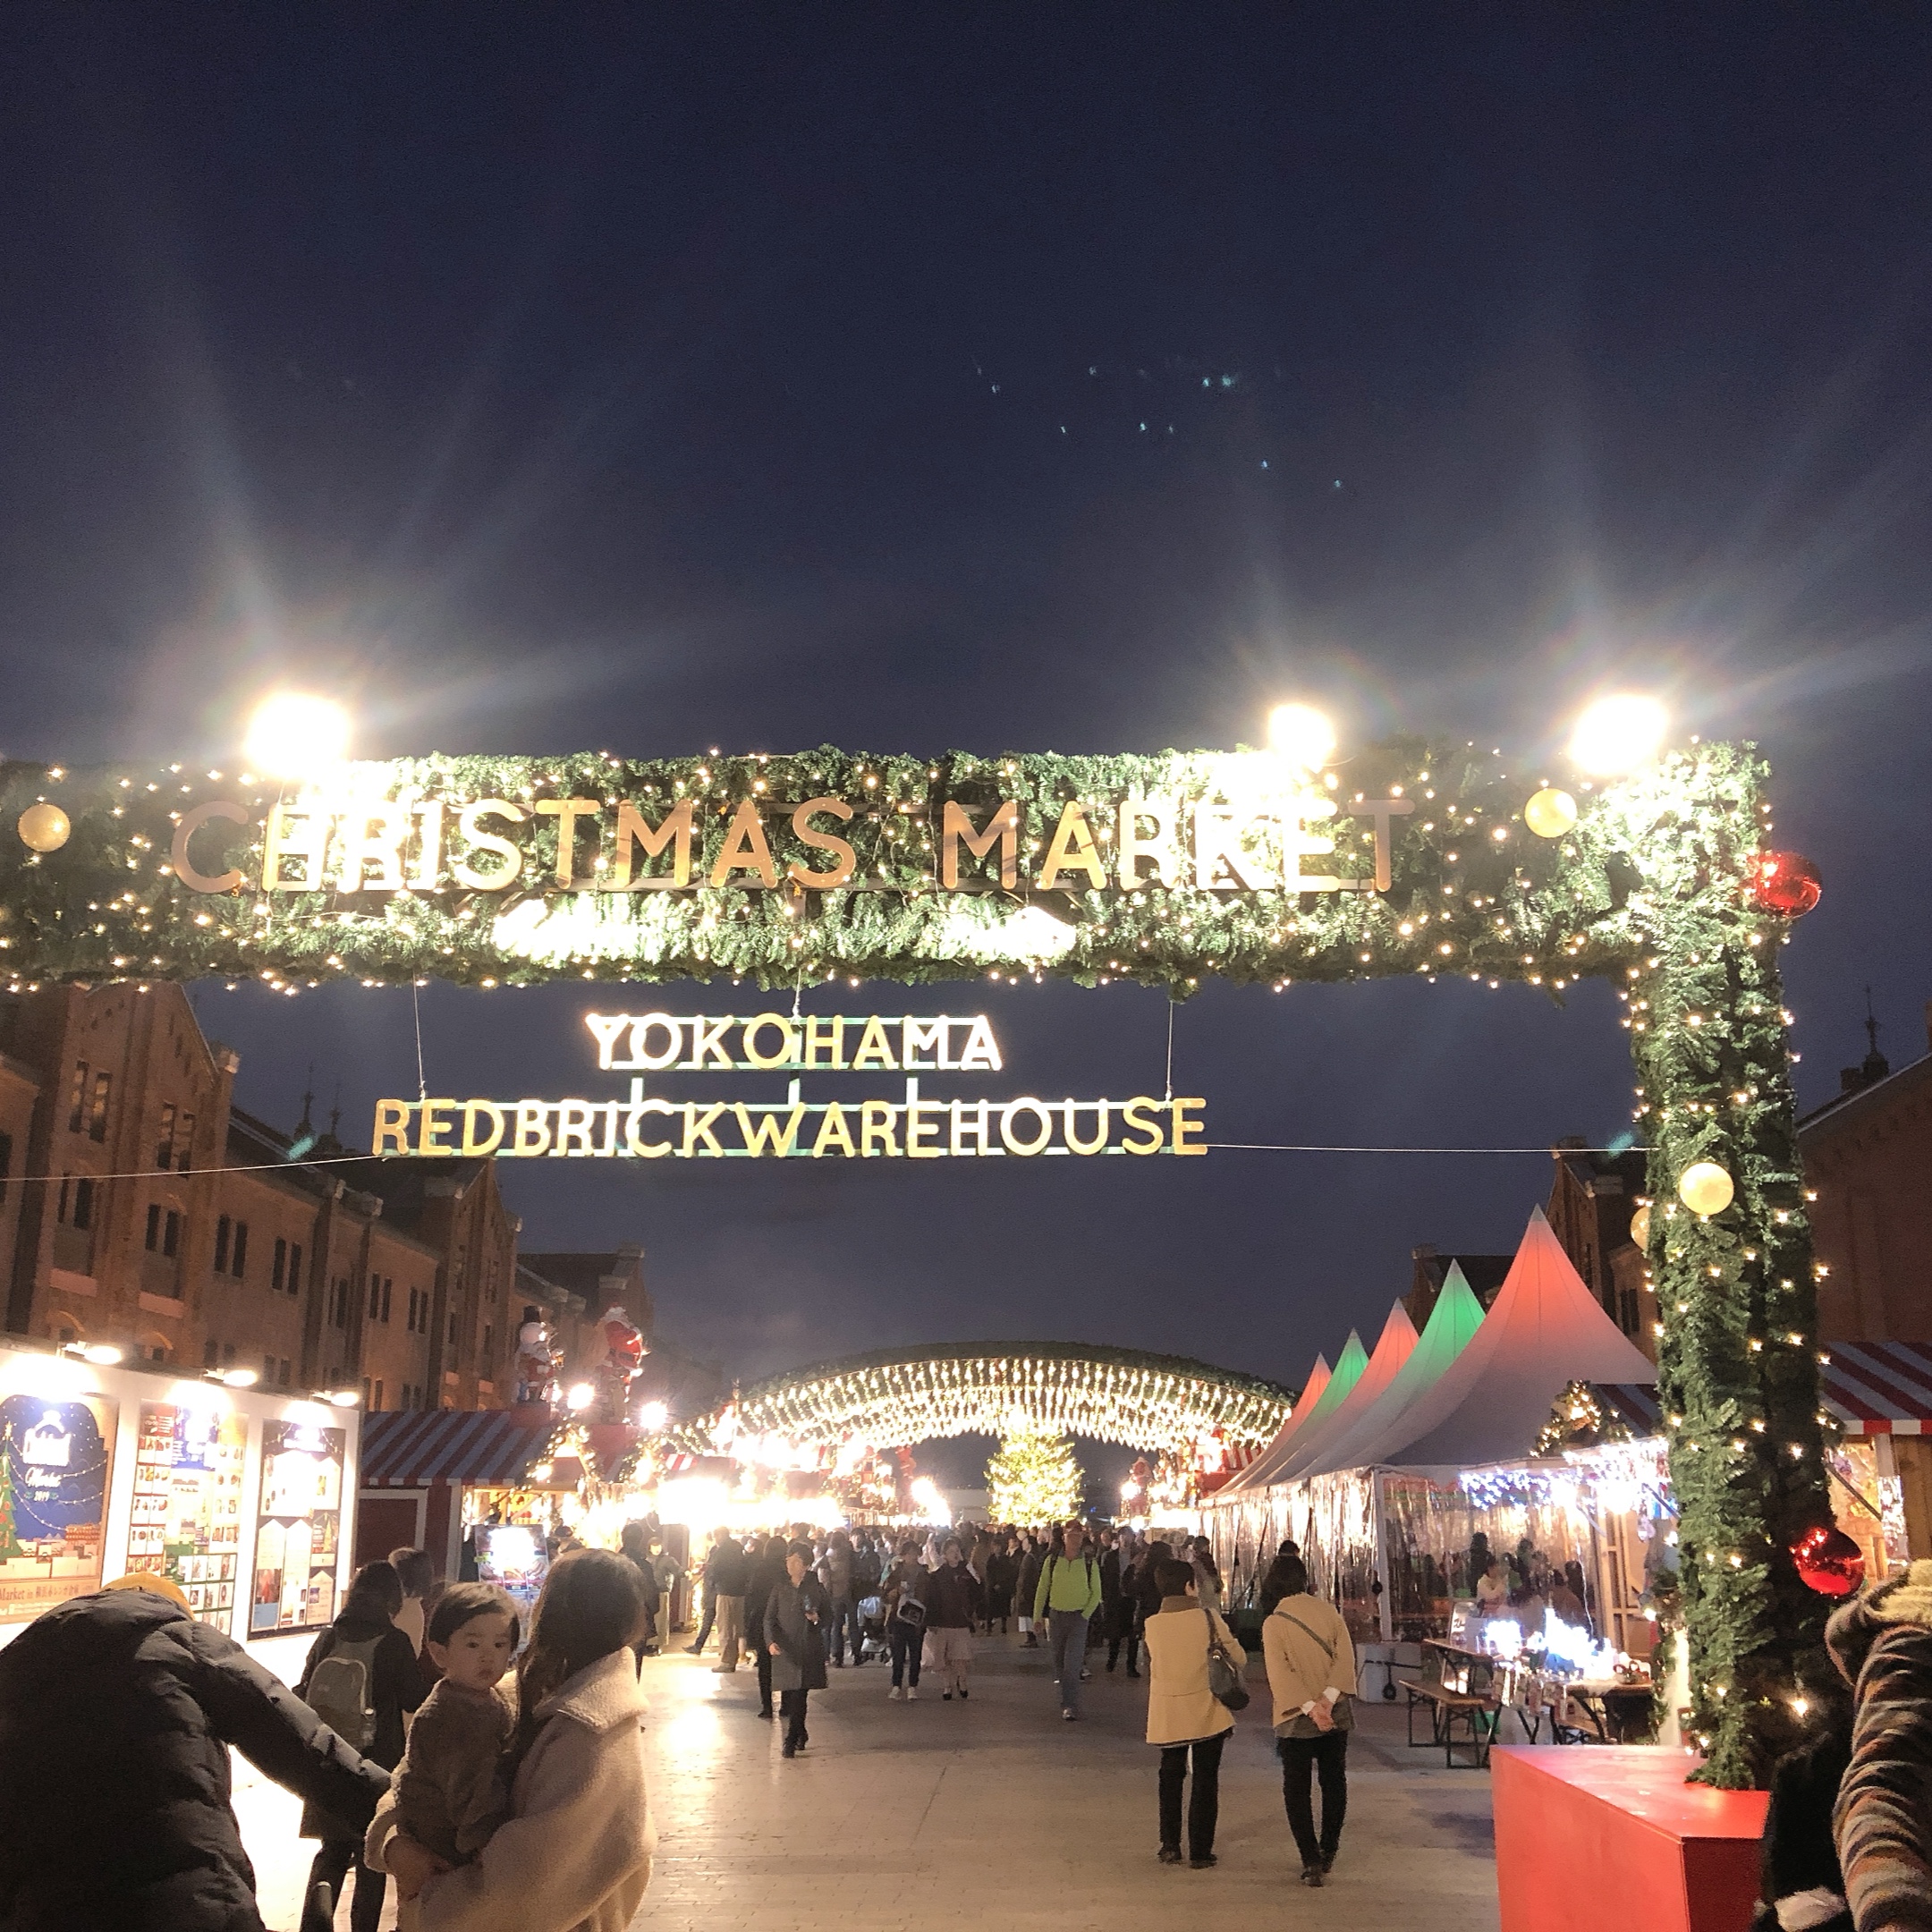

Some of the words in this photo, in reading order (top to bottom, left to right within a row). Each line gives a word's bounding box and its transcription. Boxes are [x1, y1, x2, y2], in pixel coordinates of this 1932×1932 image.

[171, 797, 856, 893] CHRISTMAS
[943, 799, 1415, 893] MARKET
[585, 1013, 1002, 1071] YOKOHAMA
